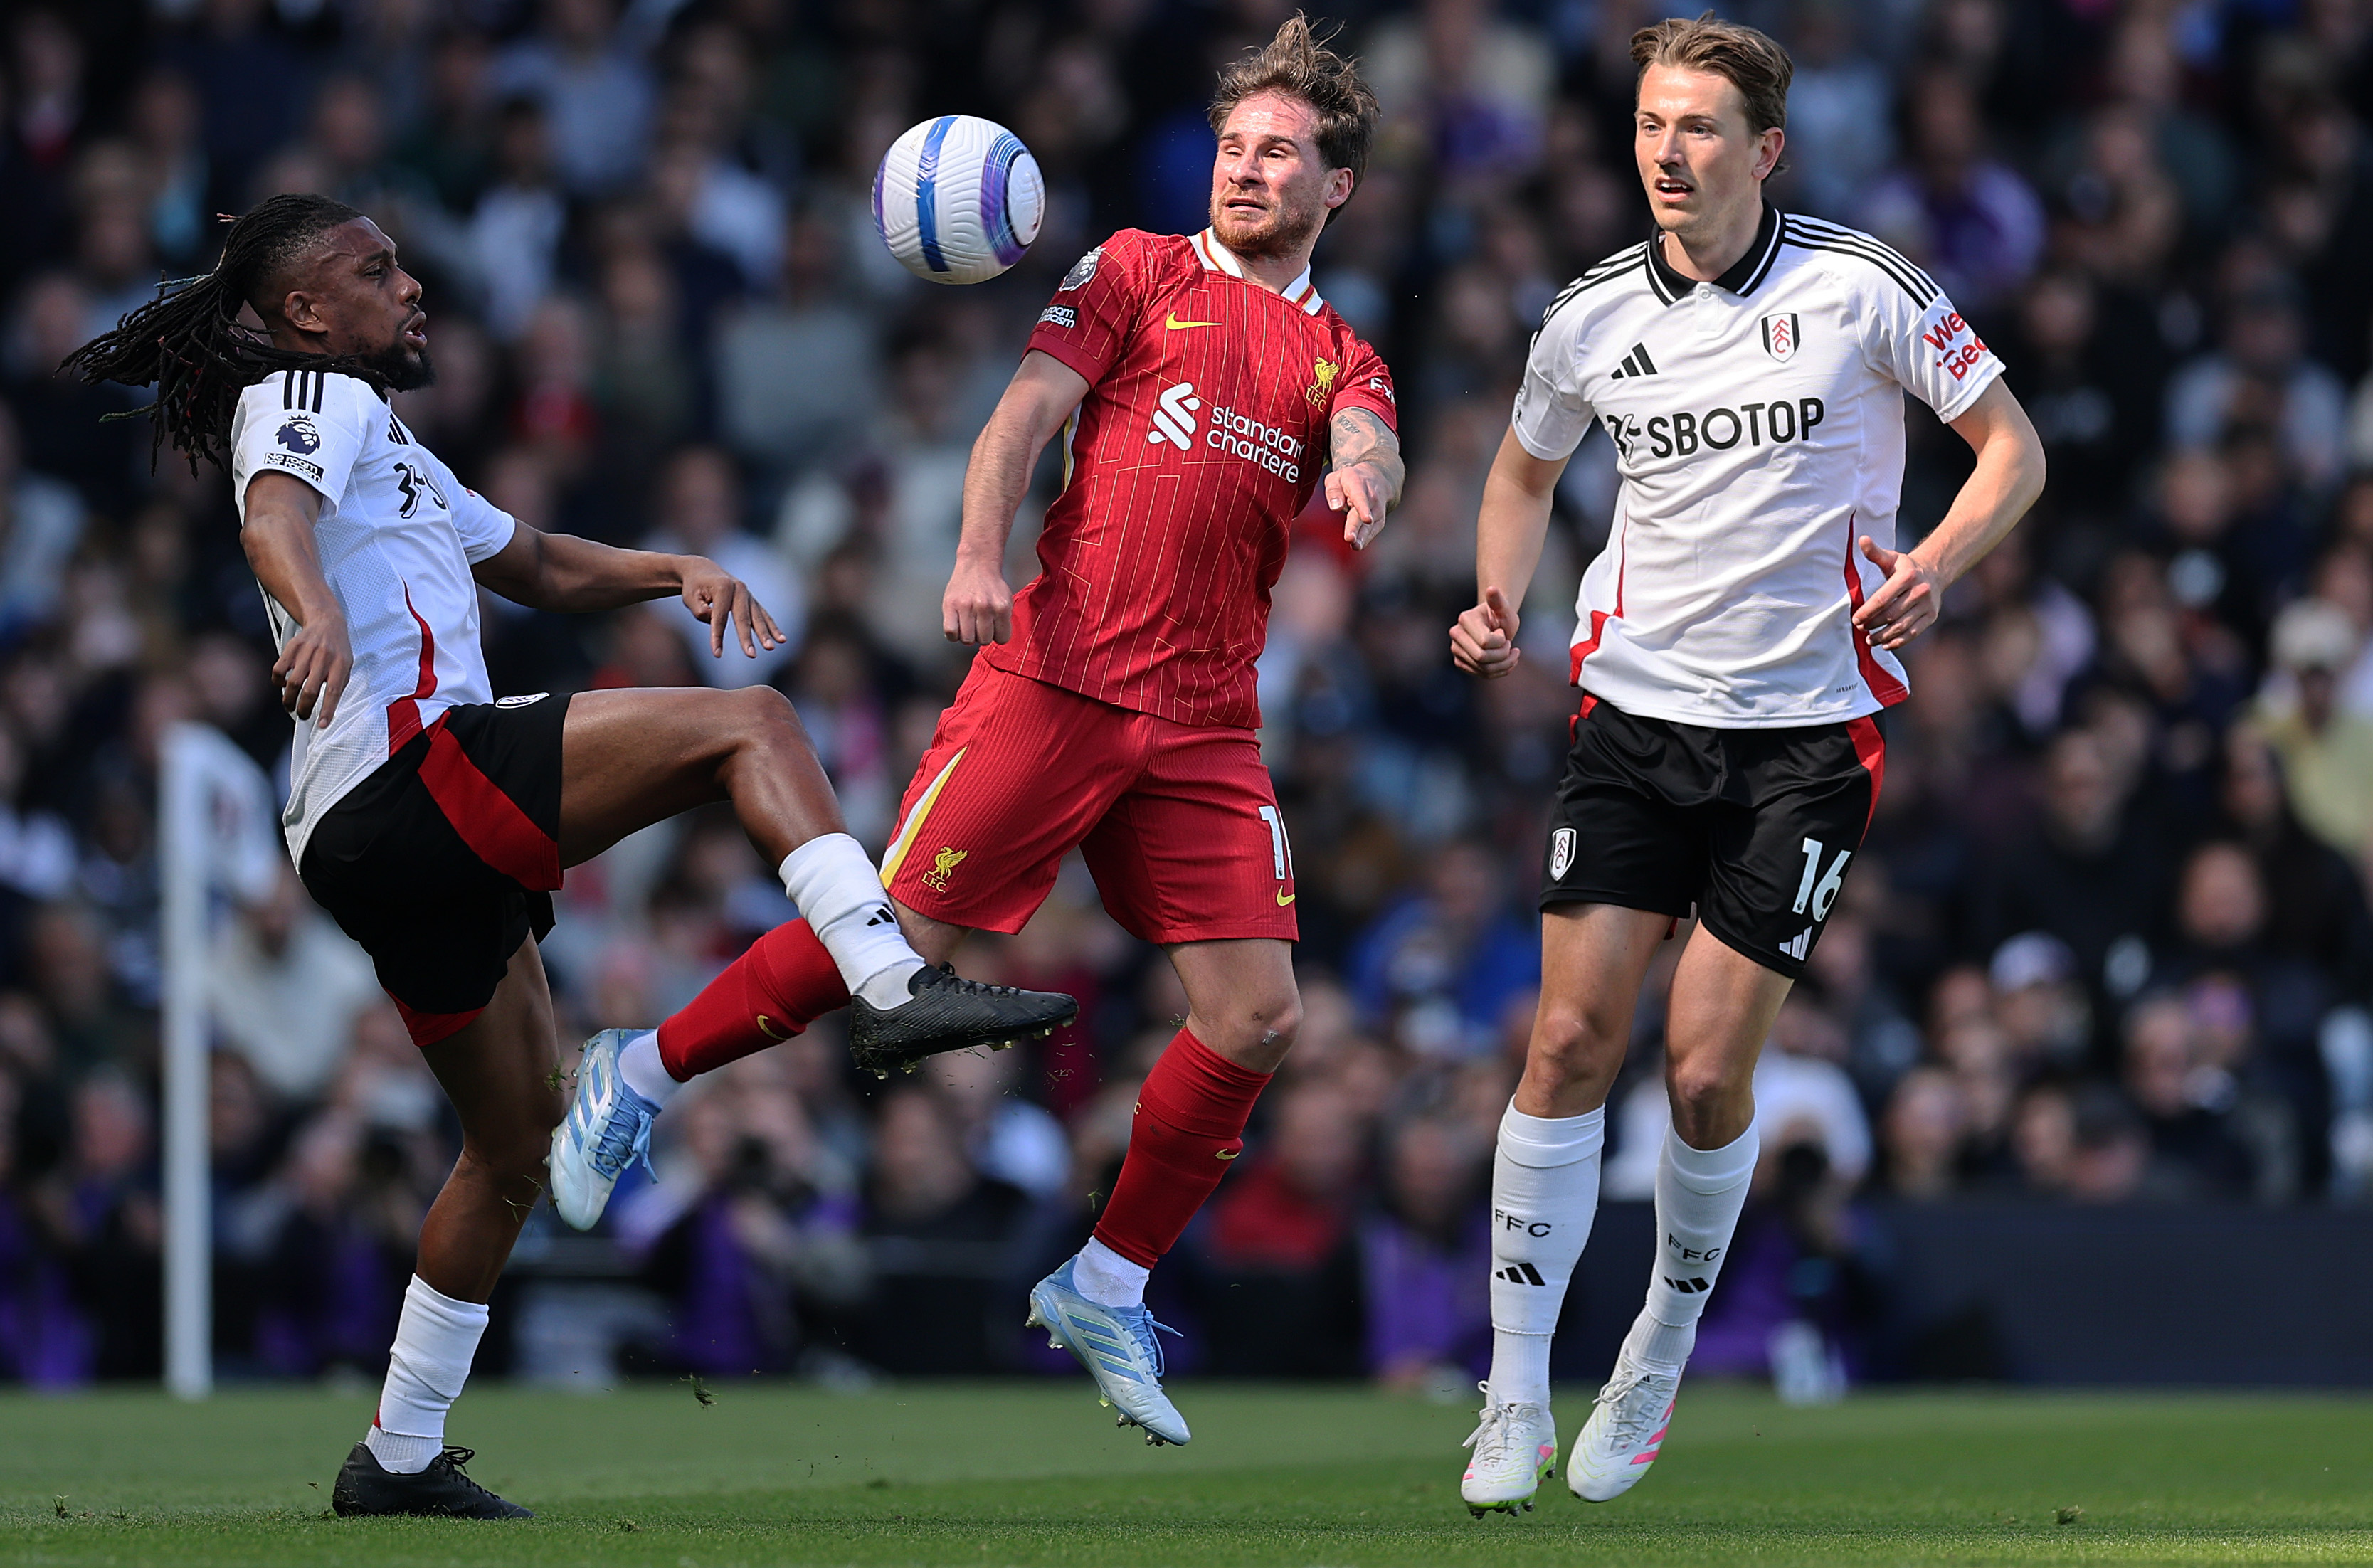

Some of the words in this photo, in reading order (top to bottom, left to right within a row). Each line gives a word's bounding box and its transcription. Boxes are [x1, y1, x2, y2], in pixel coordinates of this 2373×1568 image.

[1047, 306, 1074, 318] room
[1772, 319, 1790, 354] FFC
[1923, 313, 1965, 351] We
[1647, 397, 1824, 458] SBOTOP
[285, 461, 321, 482] racism
[286, 456, 318, 474] room
[1207, 429, 1299, 484] chartere
[1258, 805, 1294, 880] 1
[1792, 837, 1851, 923] 16
[1495, 1209, 1552, 1237] FFC
[1669, 1232, 1721, 1261] FFC
